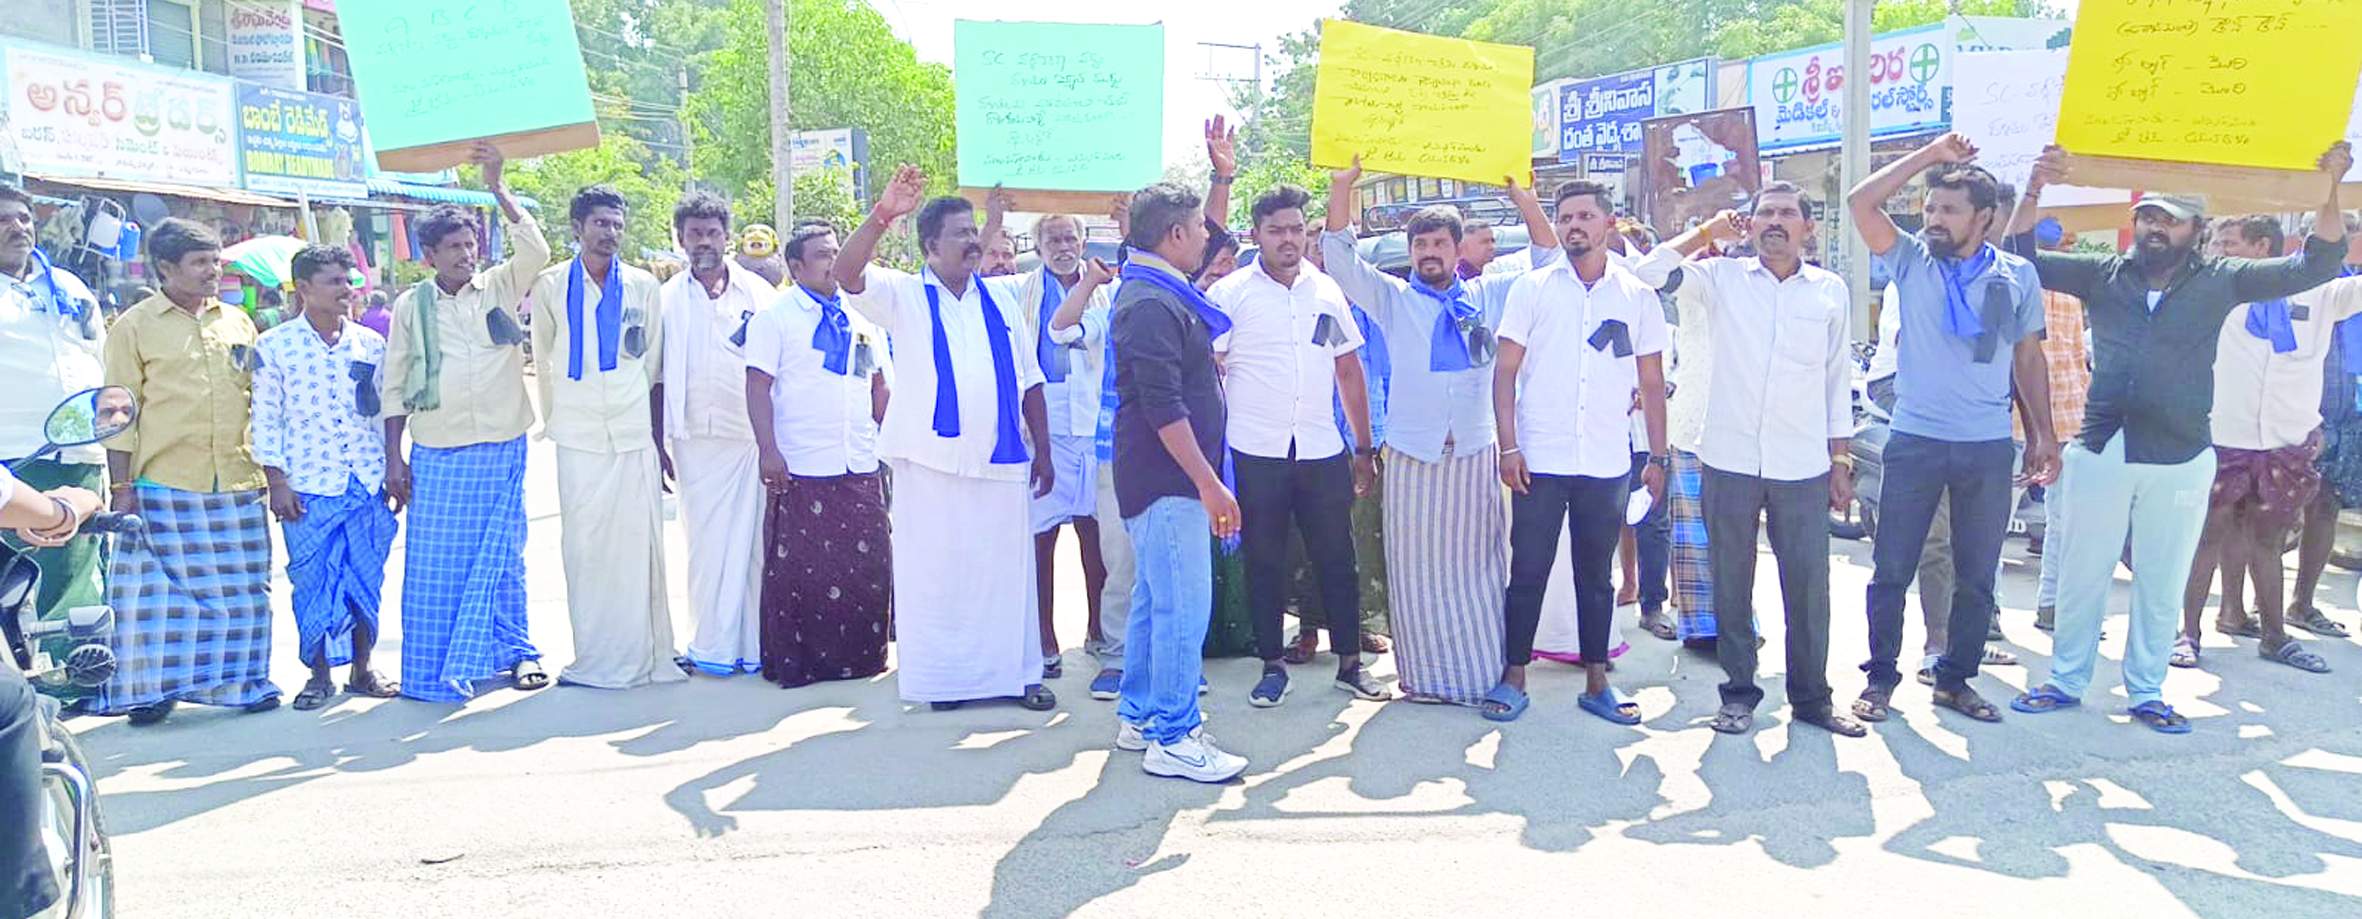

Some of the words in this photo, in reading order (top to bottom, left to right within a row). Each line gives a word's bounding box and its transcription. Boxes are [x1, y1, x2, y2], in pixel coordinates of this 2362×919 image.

[1802, 56, 1821, 103] శ్రీ
[27, 78, 129, 128] అన్వర్
[242, 99, 283, 133] బాంబే
[1562, 90, 1582, 124] శ్రీ
[1584, 80, 1652, 119] శ్రీనివాస
[1776, 98, 1829, 124] మెడికల్
[1563, 124, 1594, 150] దంత
[1595, 120, 1643, 152] వైద్యశా
